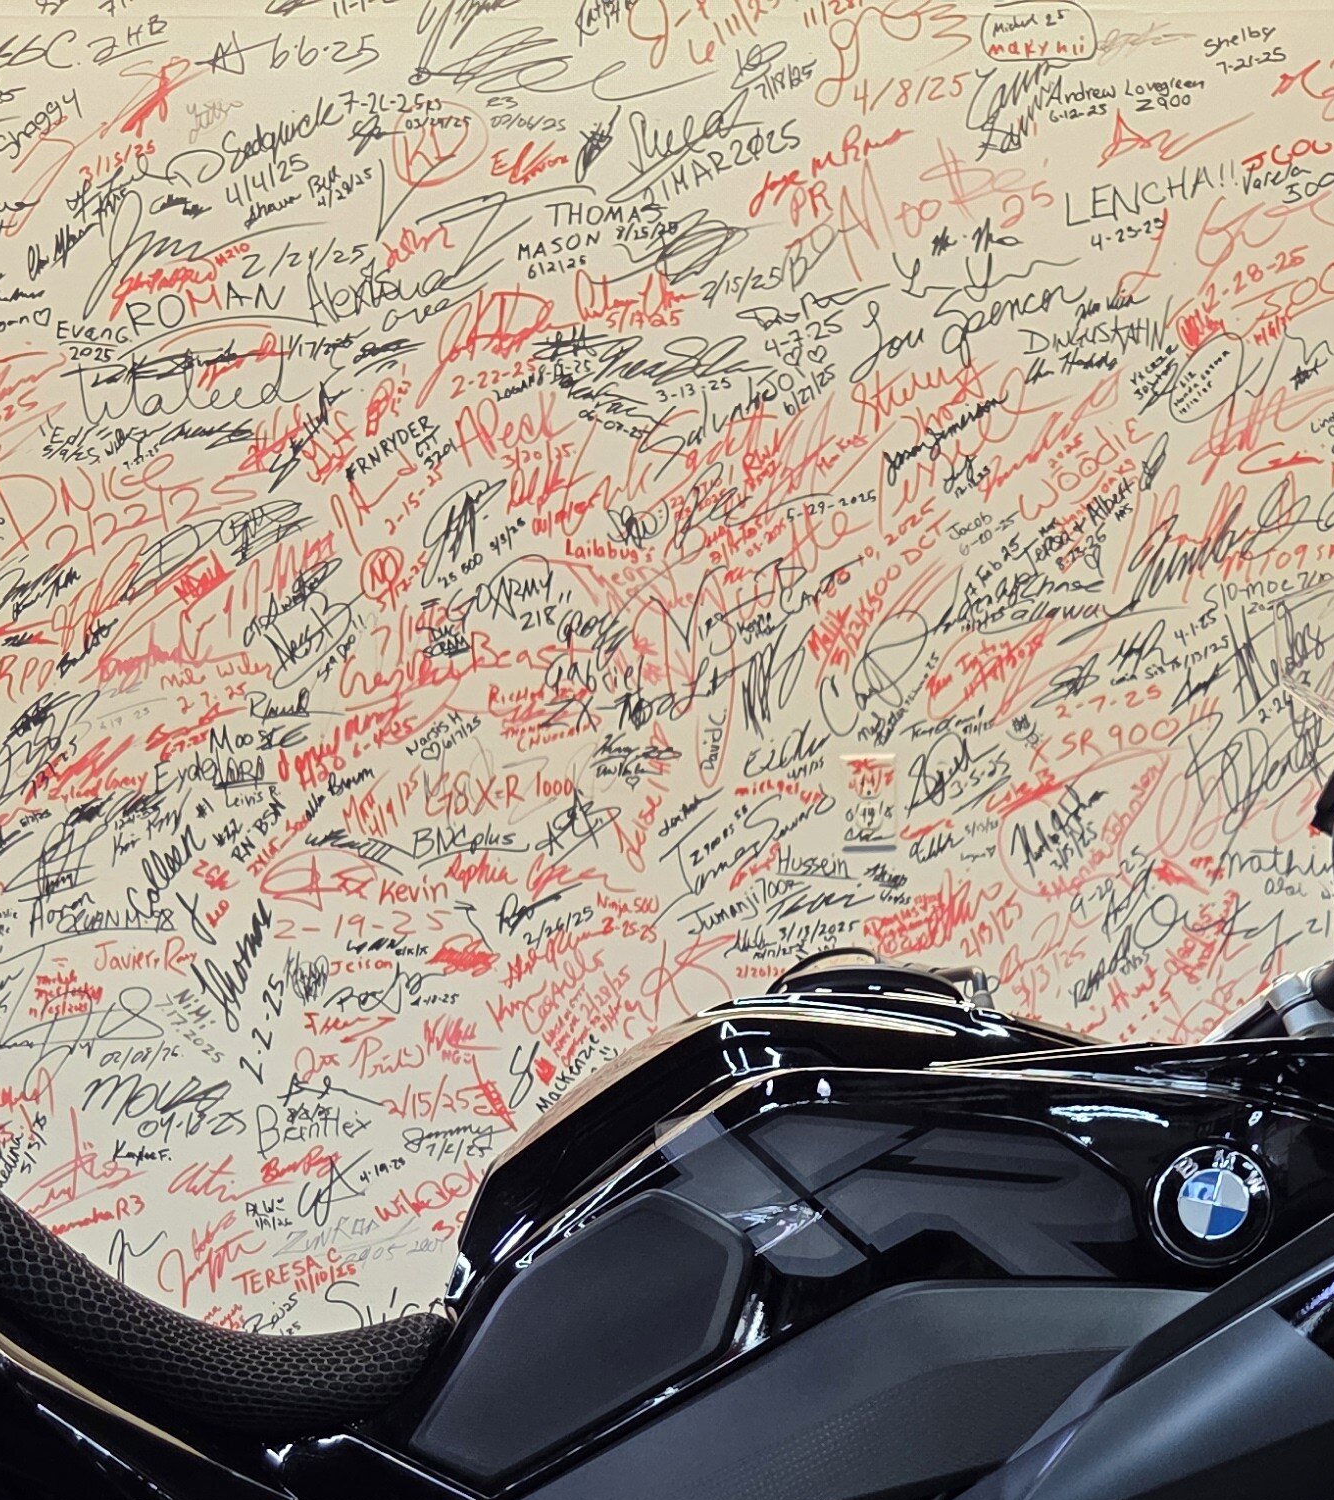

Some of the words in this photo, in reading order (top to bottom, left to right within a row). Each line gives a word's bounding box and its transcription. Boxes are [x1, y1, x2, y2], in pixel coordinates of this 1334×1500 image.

[853, 70, 971, 115] 4/8/25
[1043, 76, 1117, 105] Andrew
[1066, 158, 1239, 227] LENCHA!!
[551, 203, 666, 227] THOMAS
[519, 231, 600, 261] MASON
[700, 266, 783, 308] 2/15/25
[127, 283, 285, 336] ROMAN
[520, 605, 557, 632] 218
[1055, 684, 1161, 719] 2-7-25
[777, 846, 849, 879] Hussein
[387, 1074, 471, 1119] 2/15/25
[1173, 1149, 1267, 1195] BMW
[232, 1253, 319, 1295] TERESA
